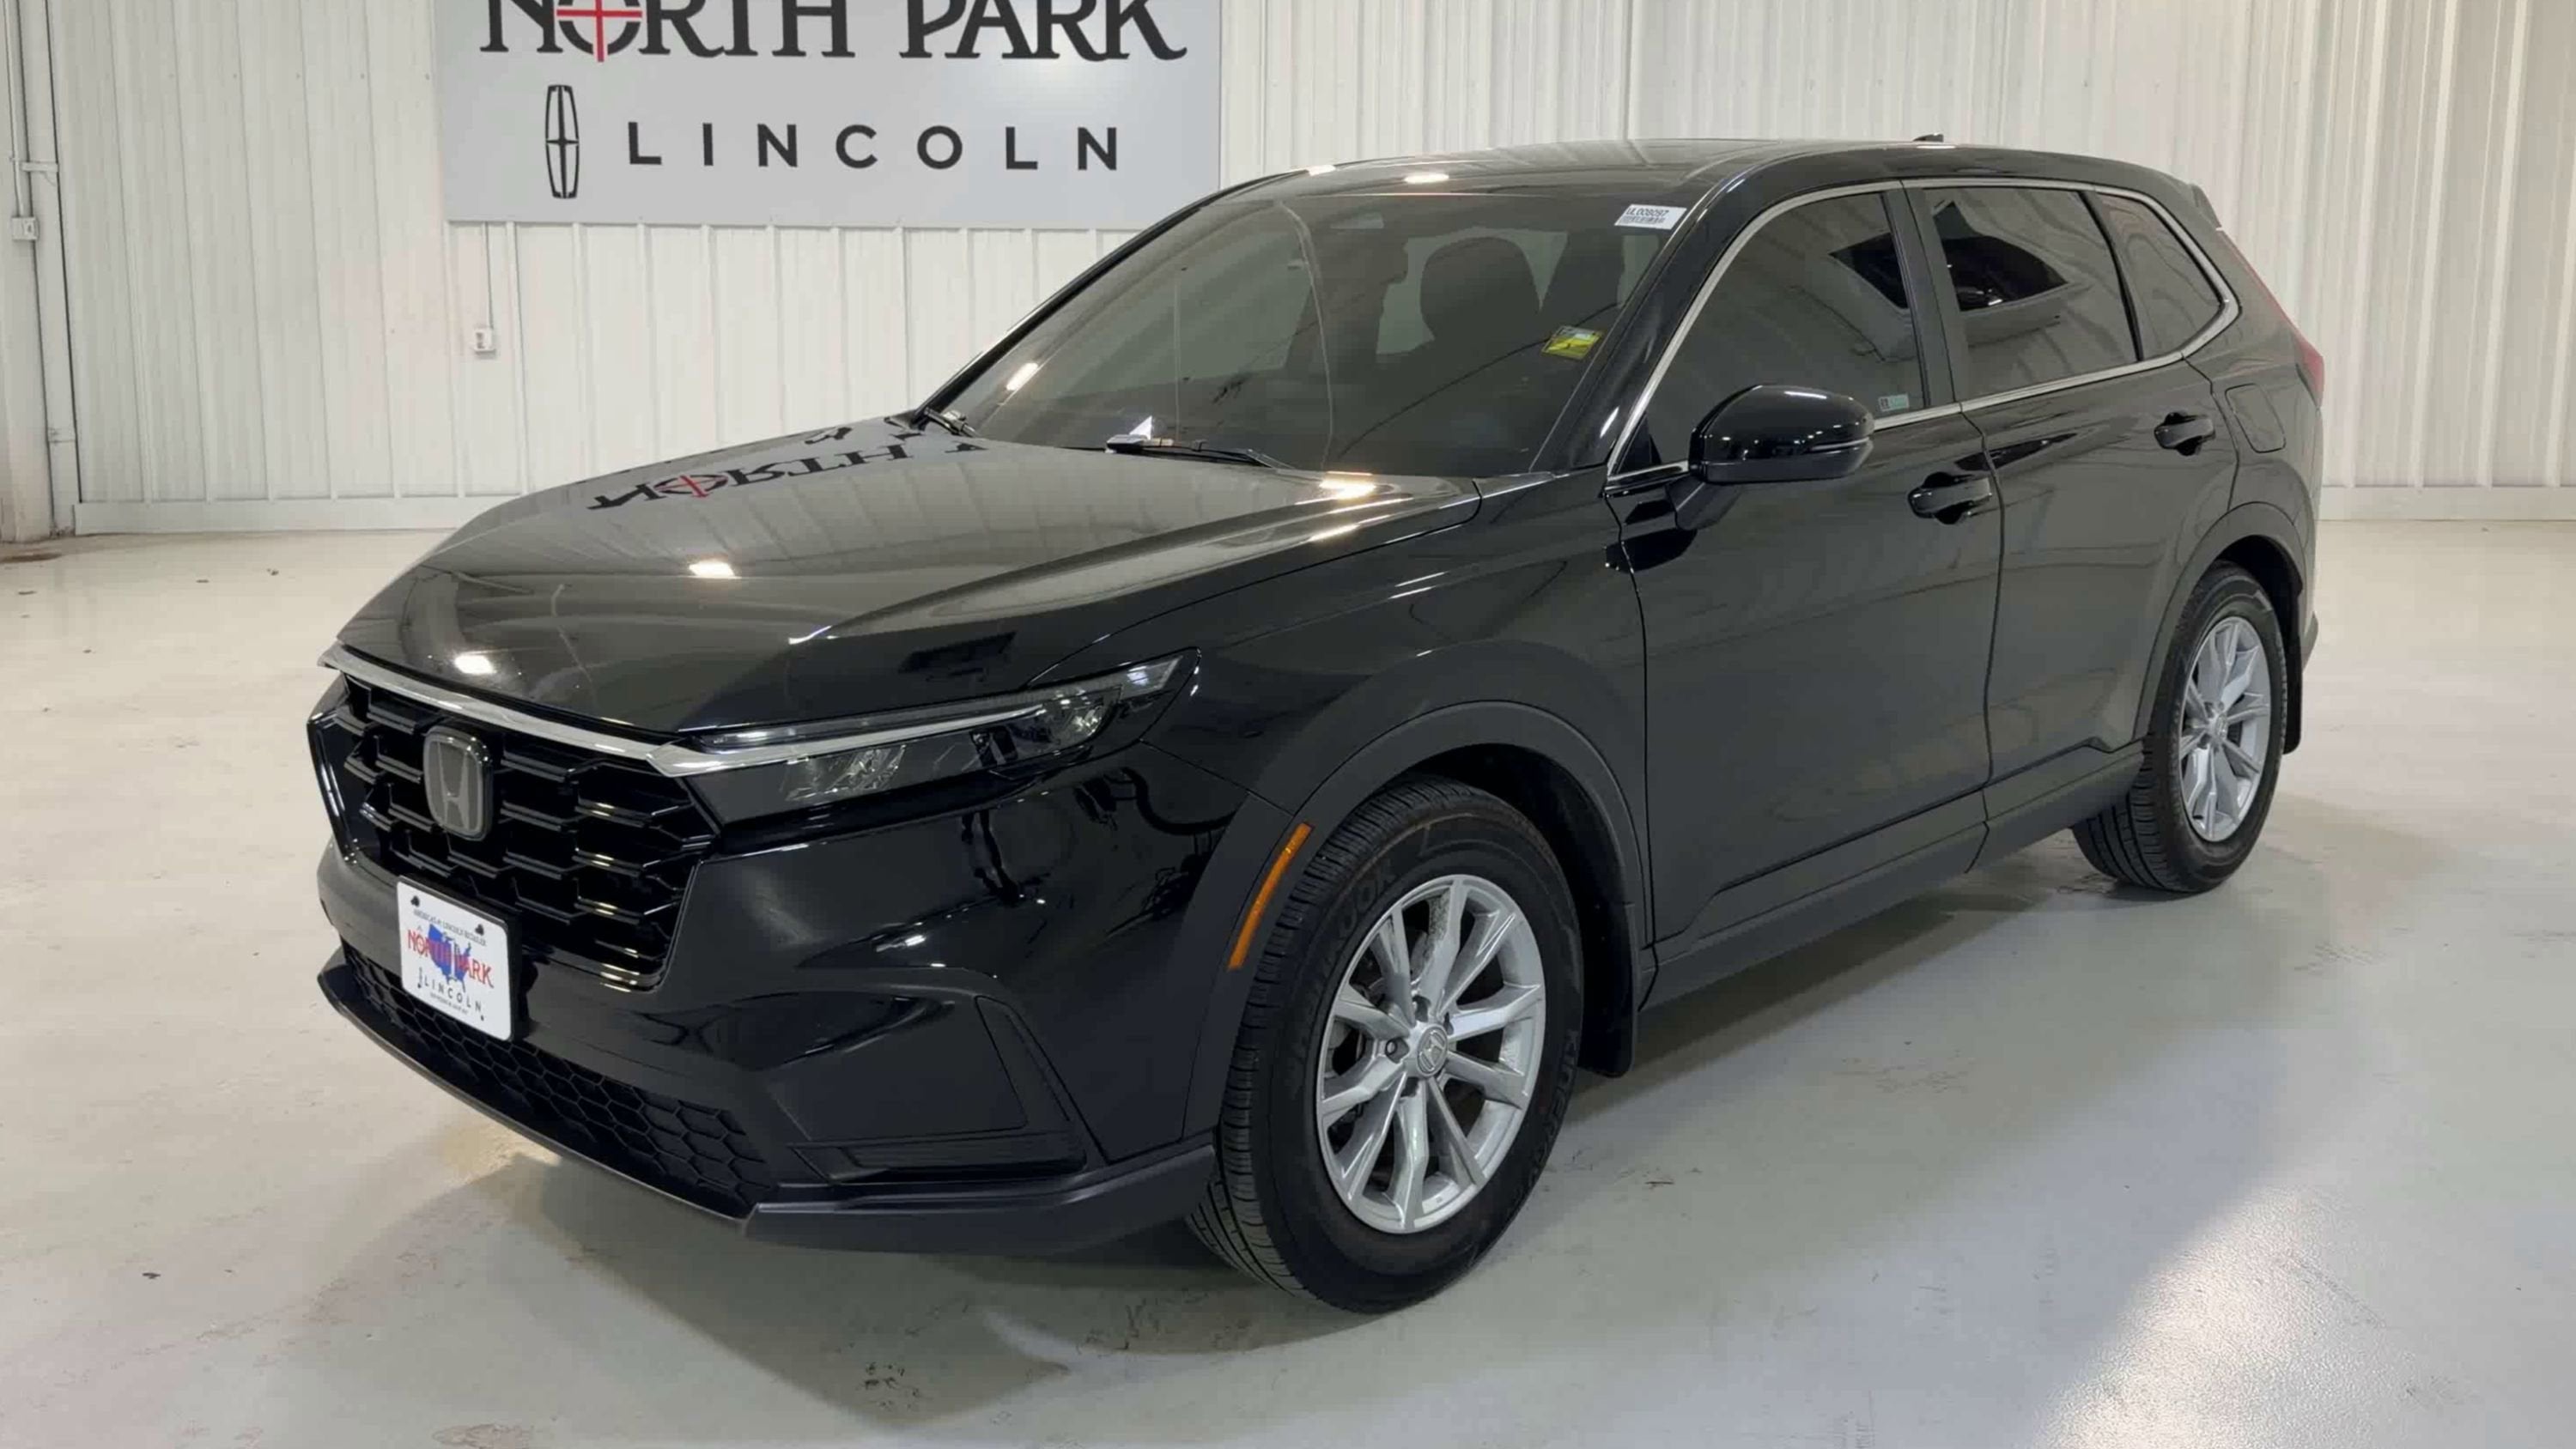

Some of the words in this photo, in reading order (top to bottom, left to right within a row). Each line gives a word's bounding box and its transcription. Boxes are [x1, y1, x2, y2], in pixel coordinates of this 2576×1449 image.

[479, 0, 856, 60] NORTH
[899, 0, 1188, 61] PARK
[628, 122, 1117, 170] LINCOLN
[424, 975, 481, 1012] LINCOLN
